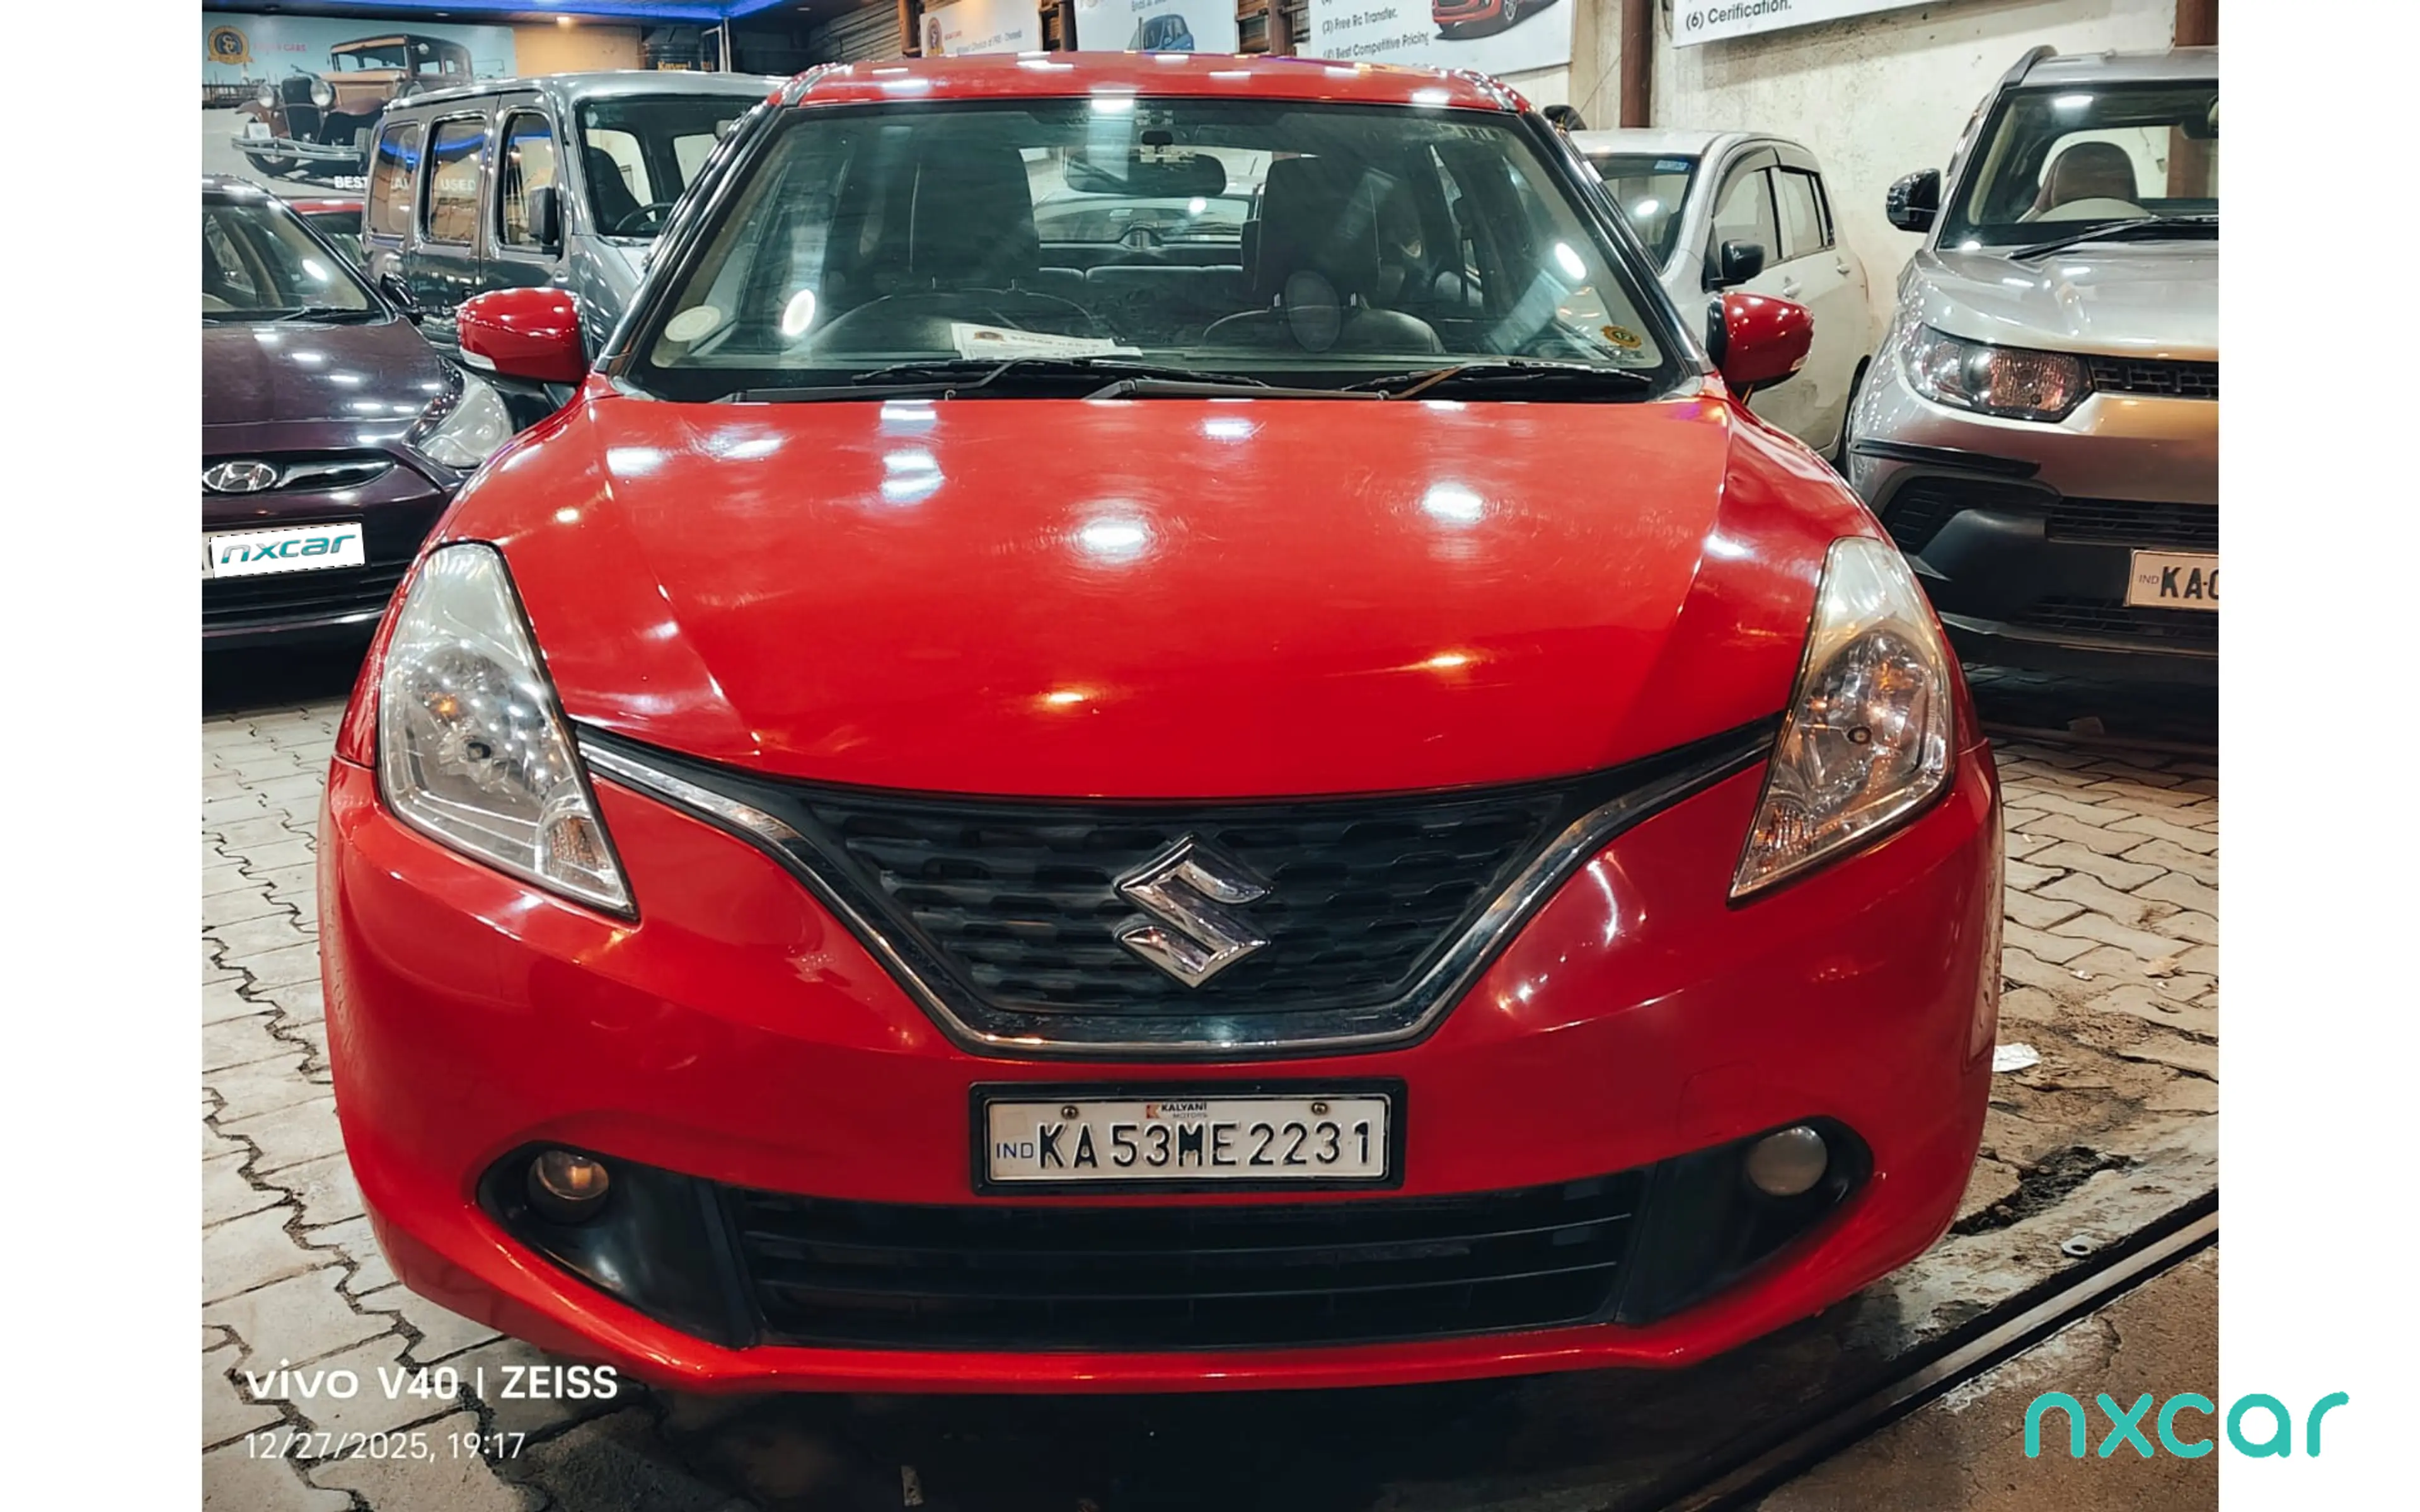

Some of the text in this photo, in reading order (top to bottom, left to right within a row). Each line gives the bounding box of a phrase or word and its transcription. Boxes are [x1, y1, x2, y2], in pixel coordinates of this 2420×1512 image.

[1335, 18, 1351, 30] Free
[1686, 12, 1704, 30] (6)
[1336, 45, 1352, 59] Best
[1352, 38, 1401, 56] Competitive
[333, 176, 368, 189] BEST
[2139, 574, 2160, 585] IND
[1161, 1101, 1207, 1113] KALYANI
[996, 1142, 1034, 1160] IND
